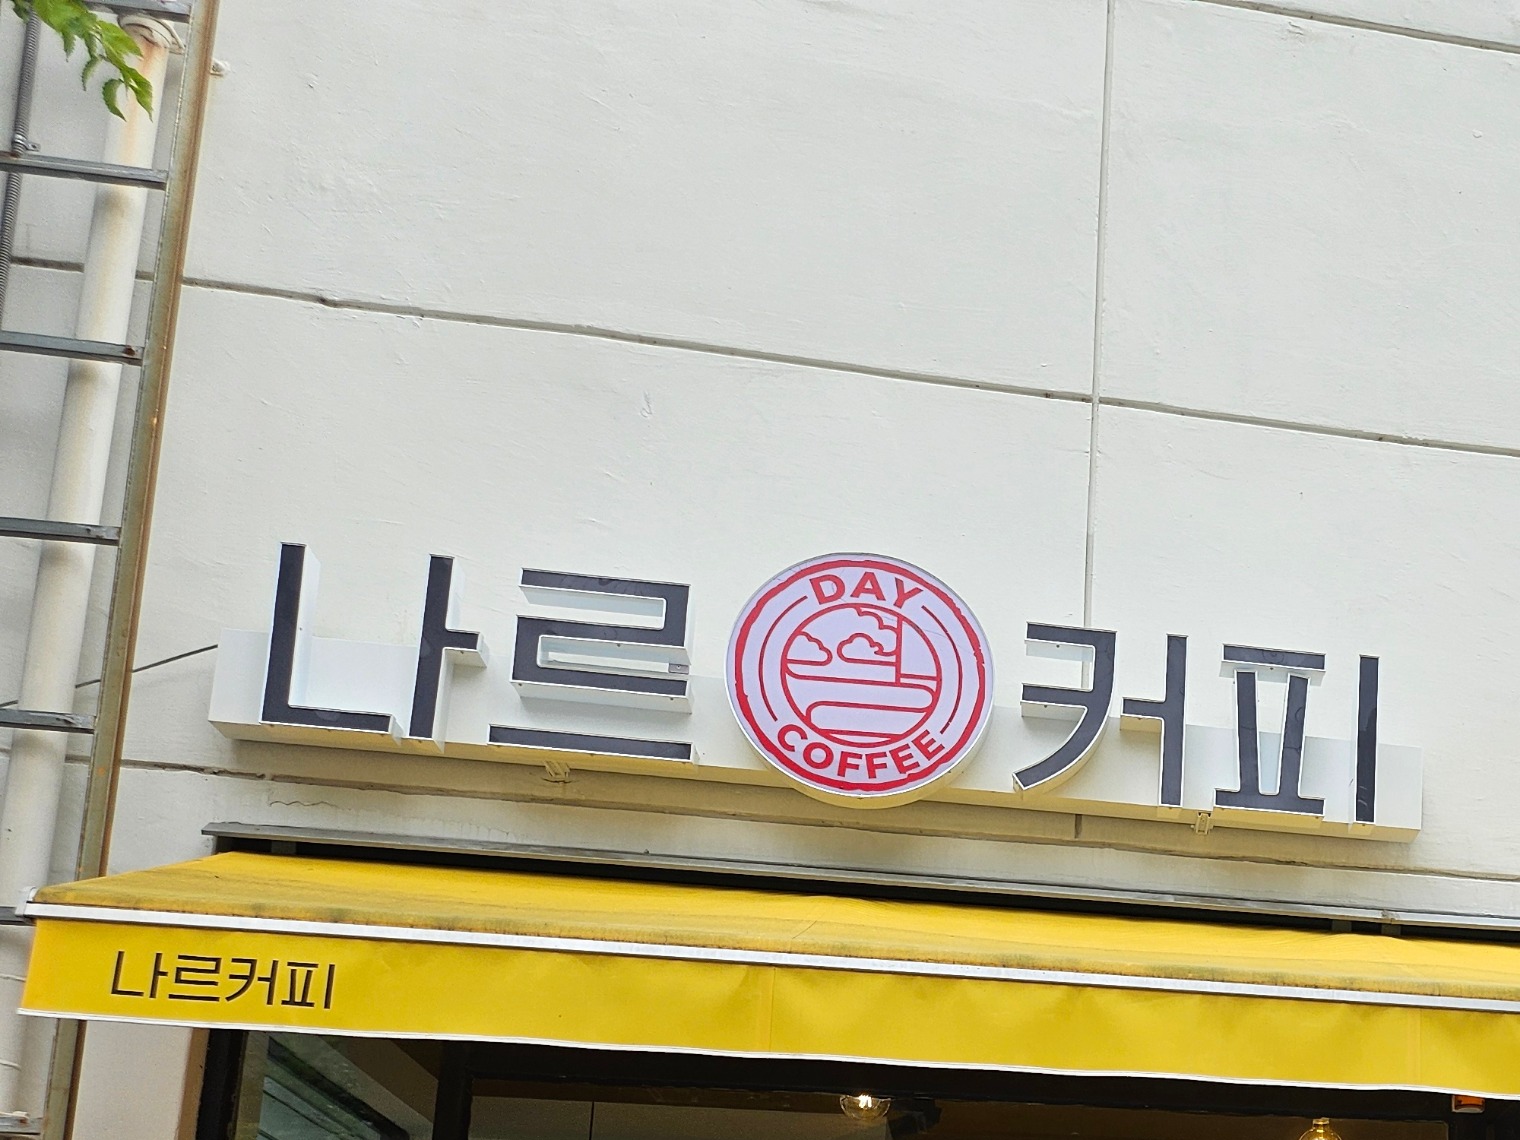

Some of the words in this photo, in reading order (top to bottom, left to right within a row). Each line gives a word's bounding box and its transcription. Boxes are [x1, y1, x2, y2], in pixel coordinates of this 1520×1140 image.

[809, 571, 924, 609] DAY
[260, 542, 692, 761] 나르
[1012, 621, 1380, 823] 커피
[777, 723, 946, 779] COFFEE
[110, 950, 336, 1010] 나르커피
